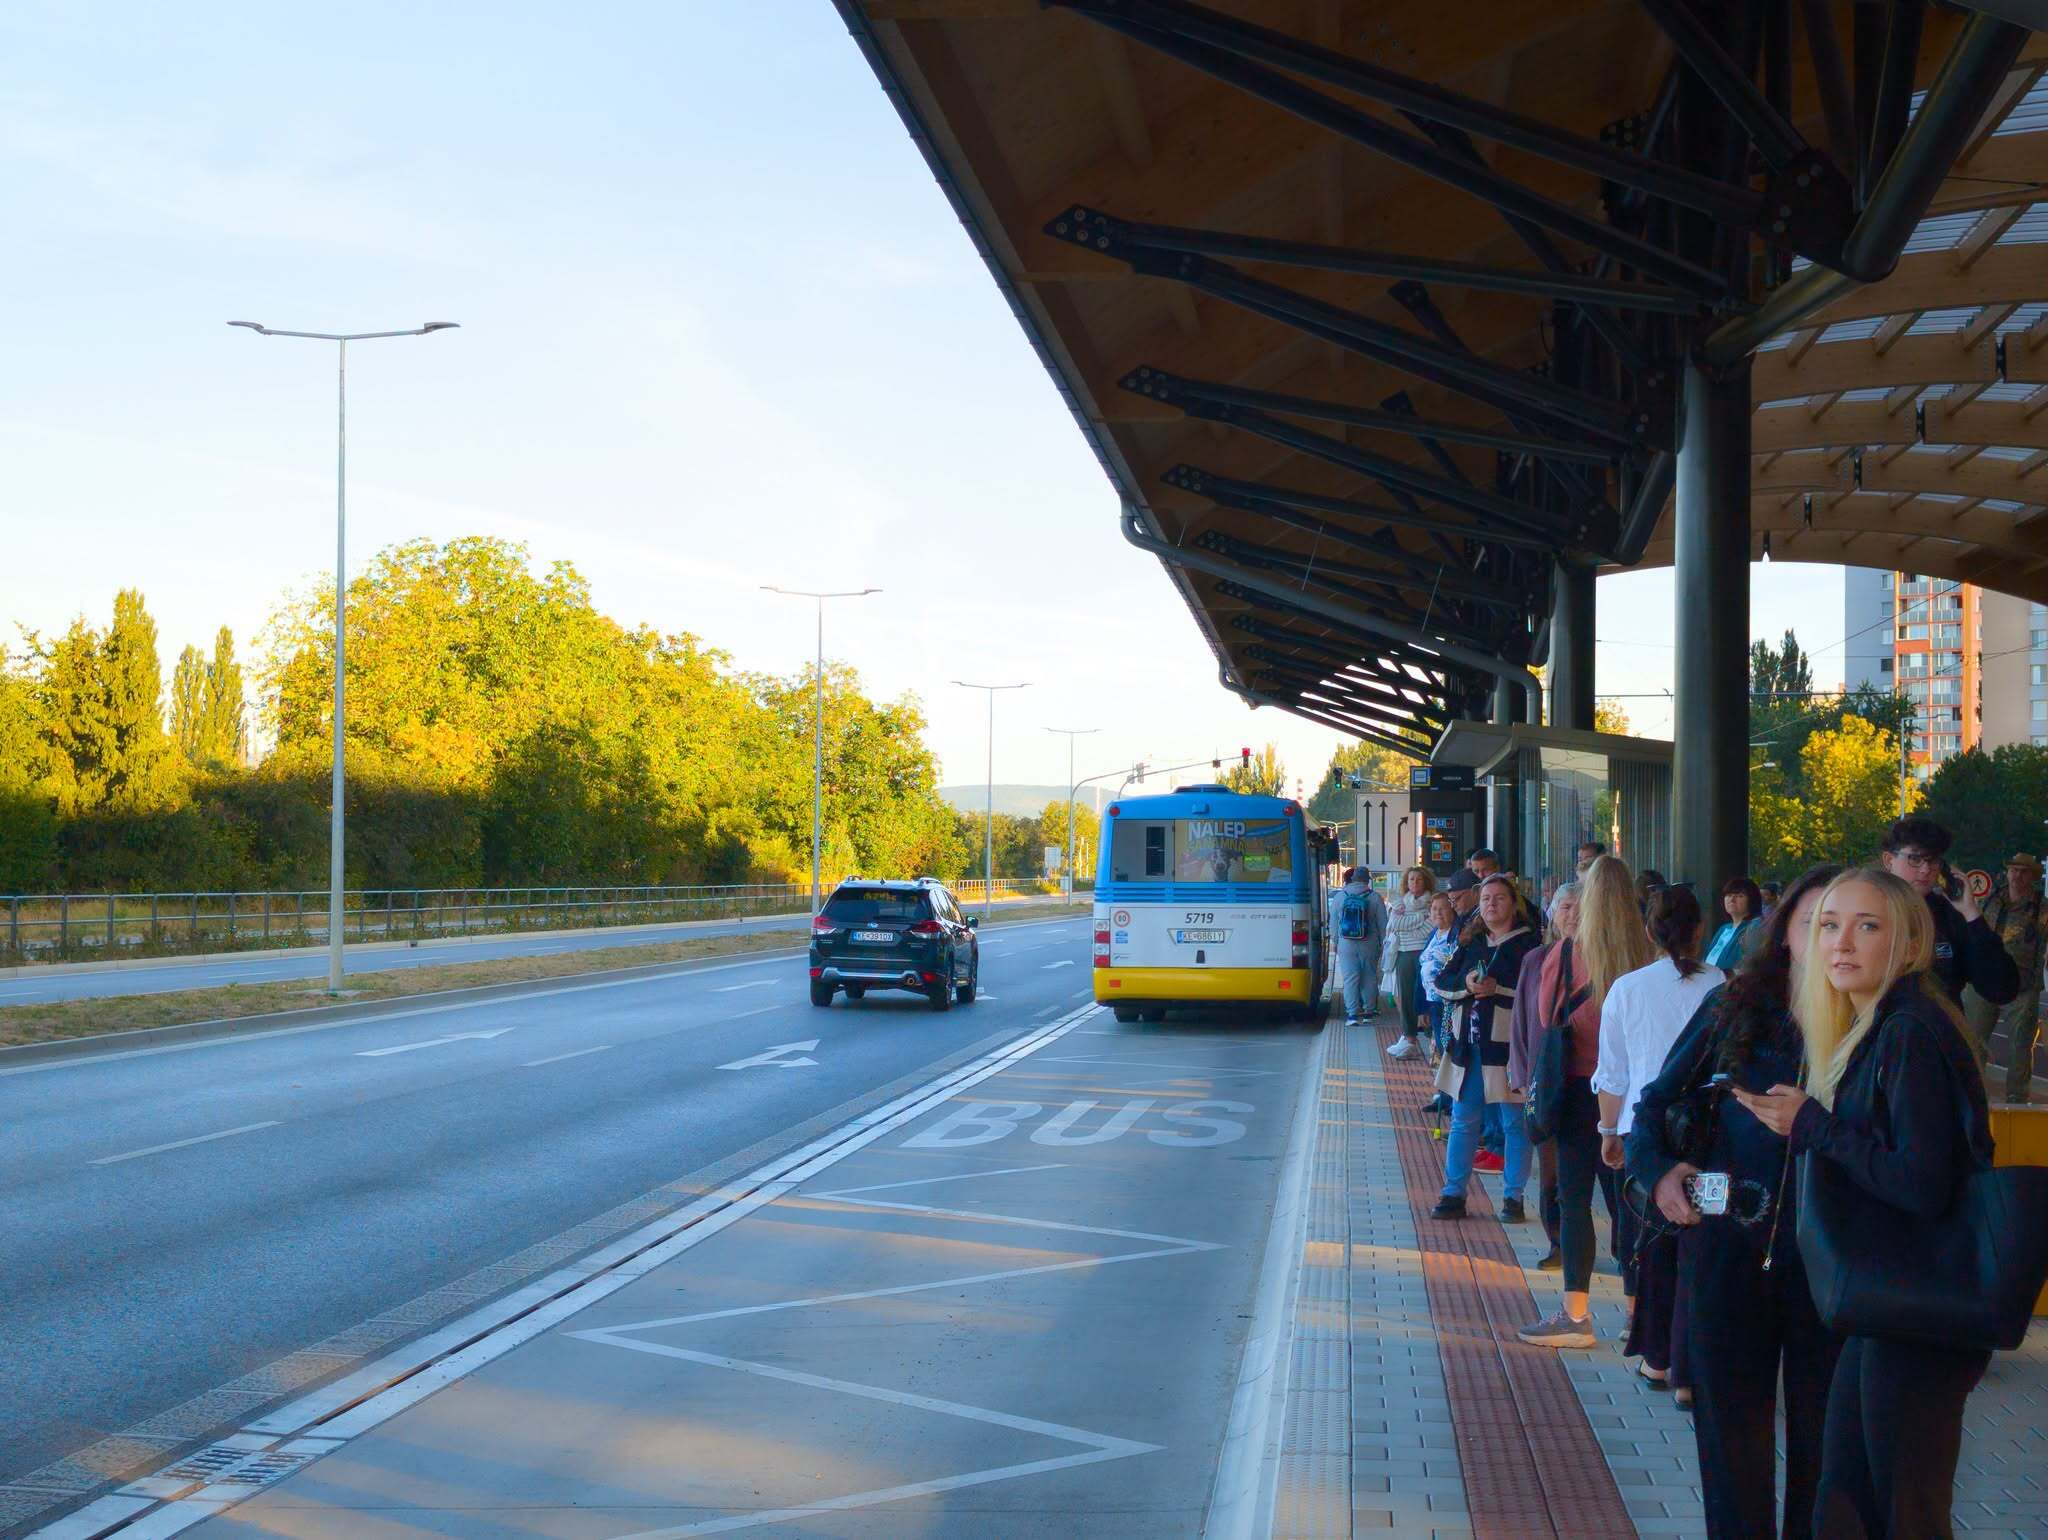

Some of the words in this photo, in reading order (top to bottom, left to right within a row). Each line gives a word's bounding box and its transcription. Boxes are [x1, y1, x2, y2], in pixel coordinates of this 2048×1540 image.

[1188, 821, 1246, 840] NALEP
[1184, 912, 1215, 924] 5719
[900, 1099, 1256, 1148] BUS
